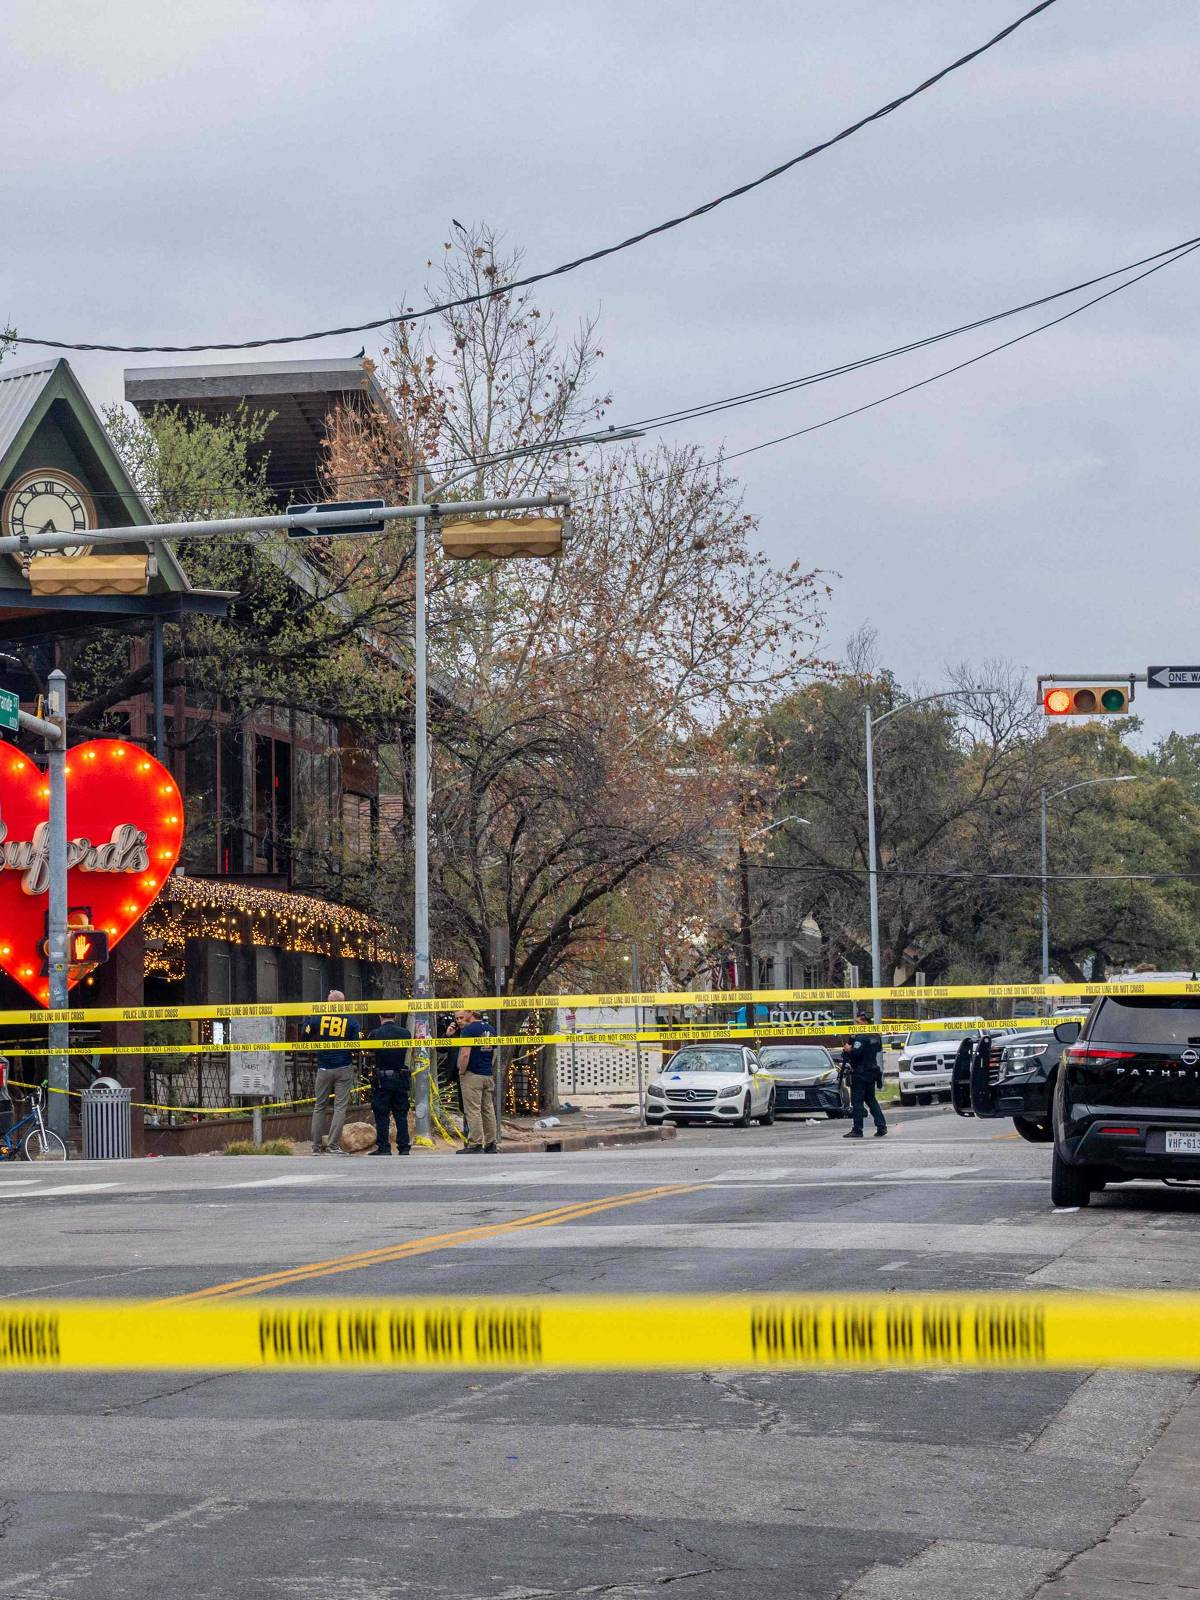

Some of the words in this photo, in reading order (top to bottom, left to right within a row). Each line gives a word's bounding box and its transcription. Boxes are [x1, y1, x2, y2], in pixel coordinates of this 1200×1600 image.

[44, 482, 55, 493] XII
[1168, 672, 1187, 682] ONE
[123, 1010, 137, 1019] POLICE
[164, 1009, 178, 1018] CROSS
[769, 1003, 832, 1028] rivers
[320, 1016, 348, 1038] FBI
[903, 1023, 921, 1031] CROSS
[620, 1033, 637, 1041] CROSS
[713, 1030, 730, 1038] CROSS
[1116, 1068, 1200, 1078] PATHFI
[259, 1309, 327, 1362] POLICE
[336, 1309, 380, 1362] LINE
[389, 1309, 416, 1362] DO
[424, 1309, 463, 1362] NOT
[474, 1309, 542, 1362] CROSS
[751, 1305, 822, 1361] POLICE
[831, 1305, 877, 1361] LINE
[886, 1305, 914, 1361] DO
[922, 1305, 962, 1361] NOT
[974, 1305, 1046, 1361] CROSS
